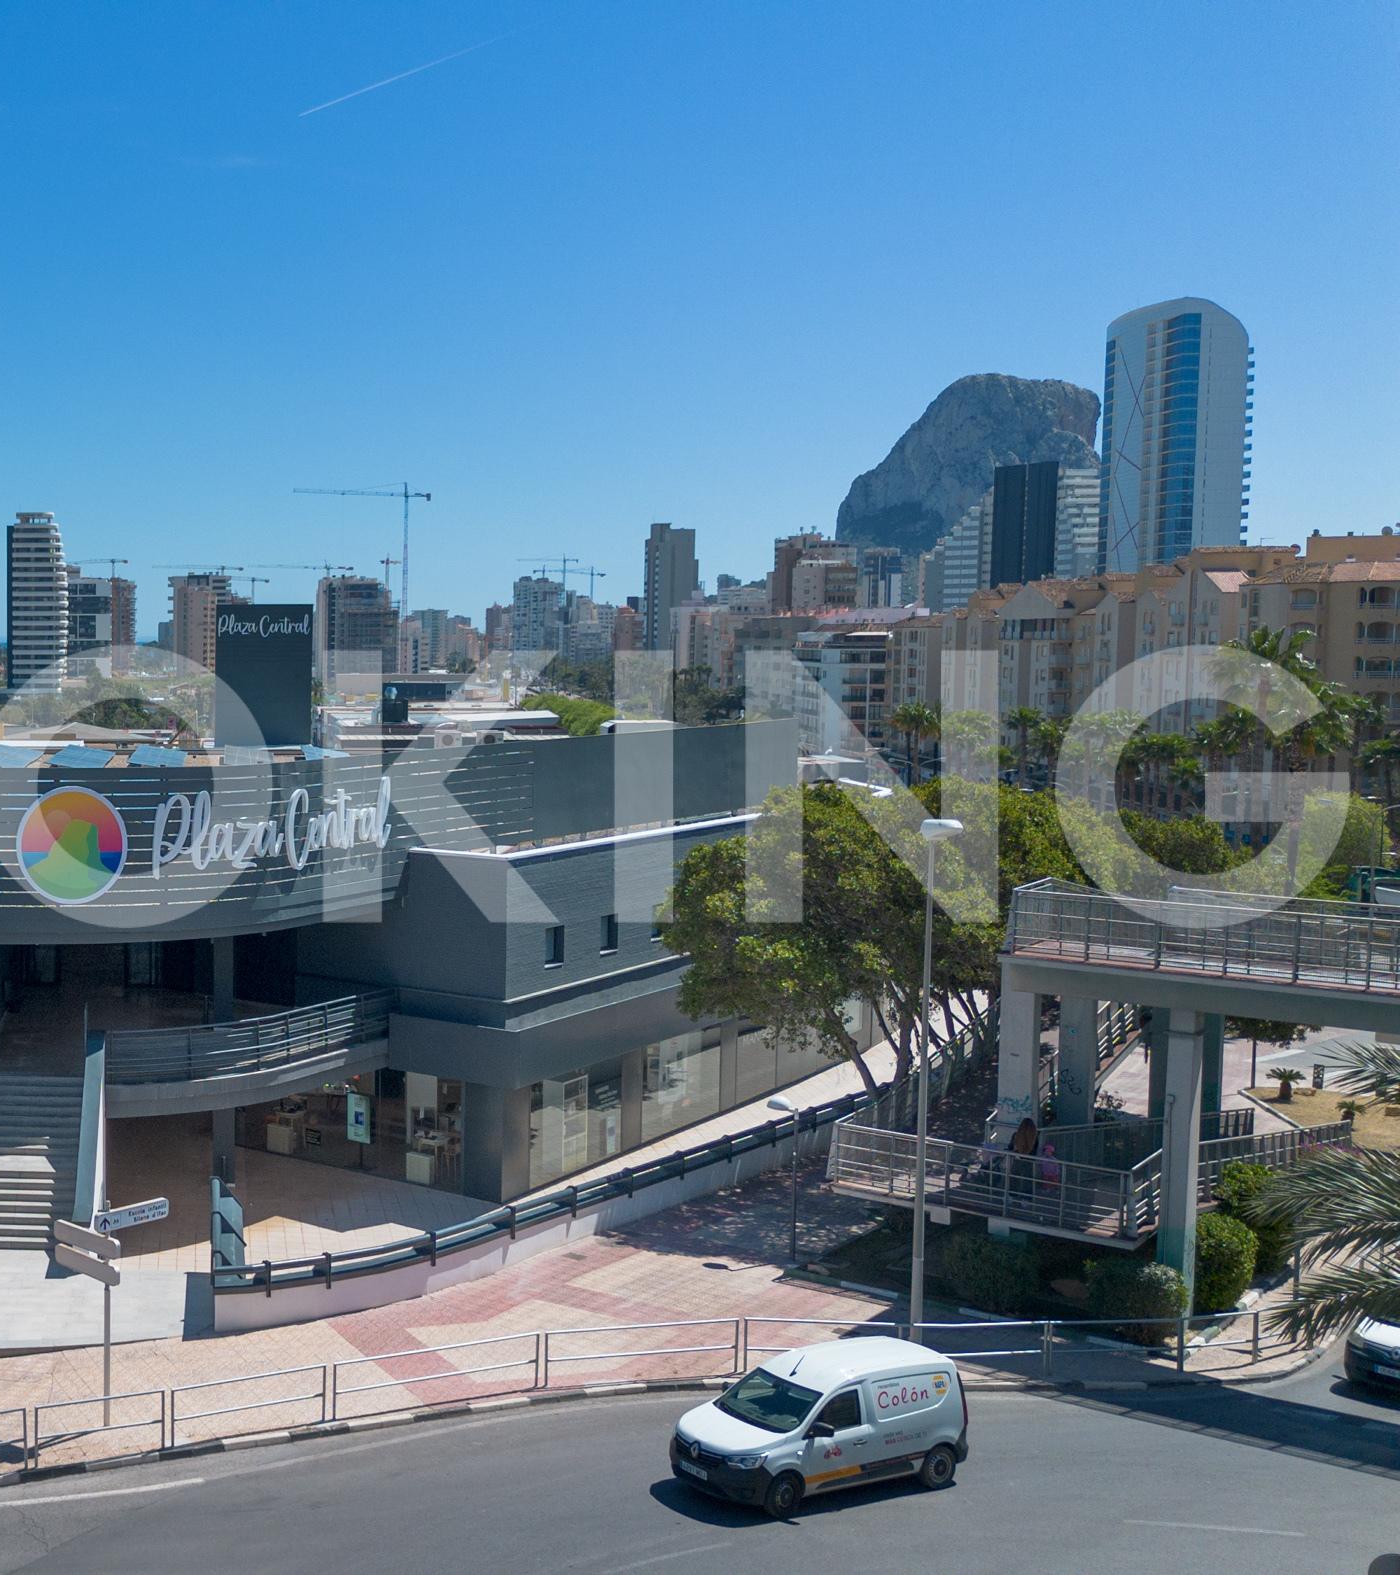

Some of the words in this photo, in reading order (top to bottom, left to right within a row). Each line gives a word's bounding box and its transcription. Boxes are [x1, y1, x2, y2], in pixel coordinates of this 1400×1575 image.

[218, 614, 258, 637] Plaza
[259, 614, 311, 638] Central
[152, 790, 284, 880] Plaza
[285, 776, 392, 870] Central
[878, 1387, 929, 1409] Colón
